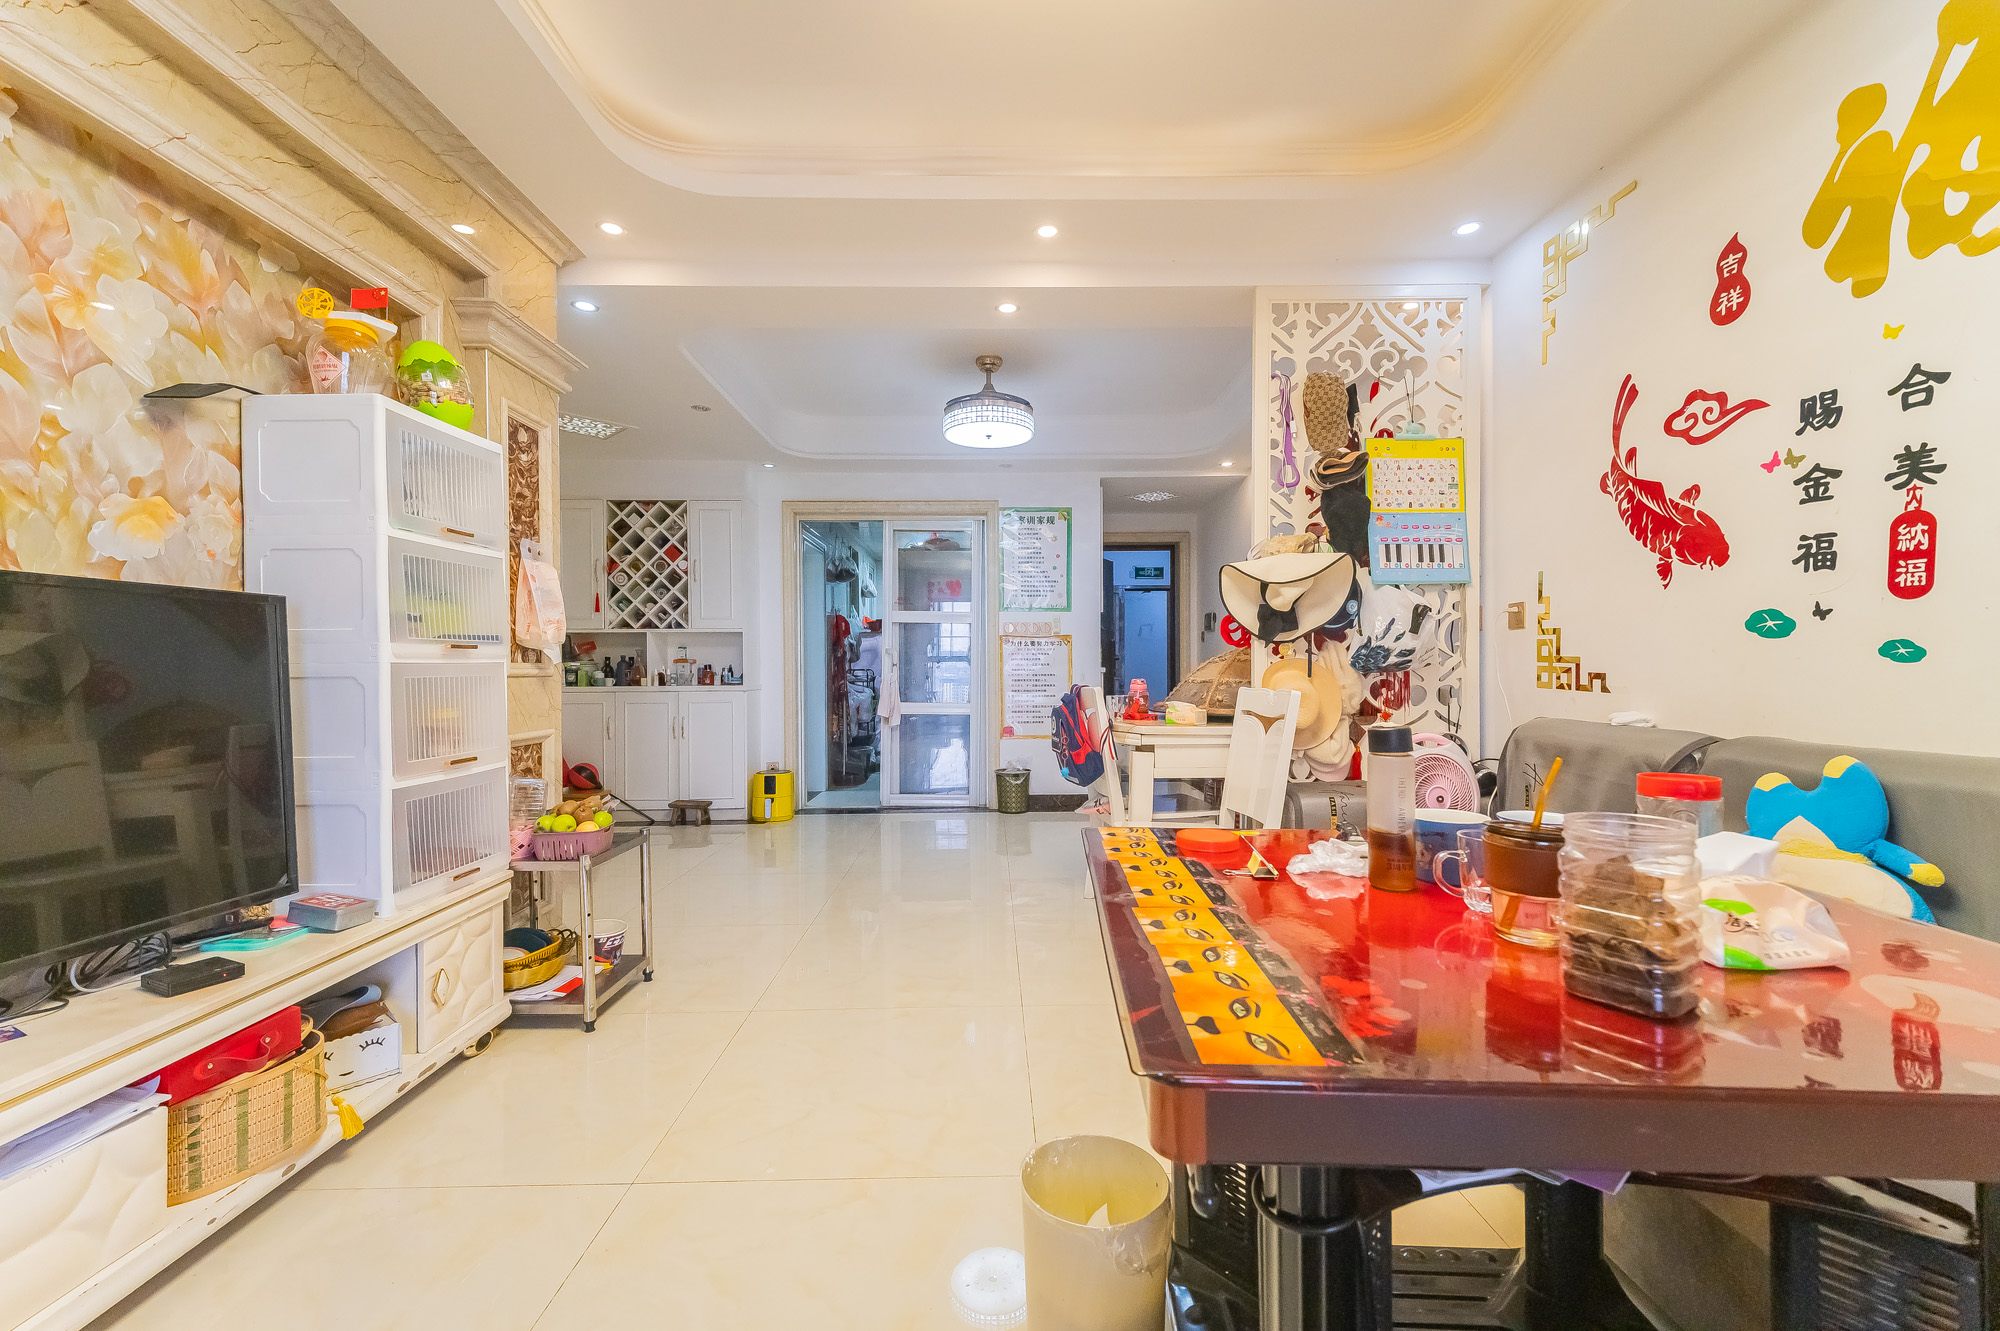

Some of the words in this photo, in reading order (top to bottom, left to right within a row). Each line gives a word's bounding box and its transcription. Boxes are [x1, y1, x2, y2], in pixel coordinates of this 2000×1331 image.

[1716, 252, 1744, 316] 吉祥
[1791, 388, 1844, 574] 赐金福
